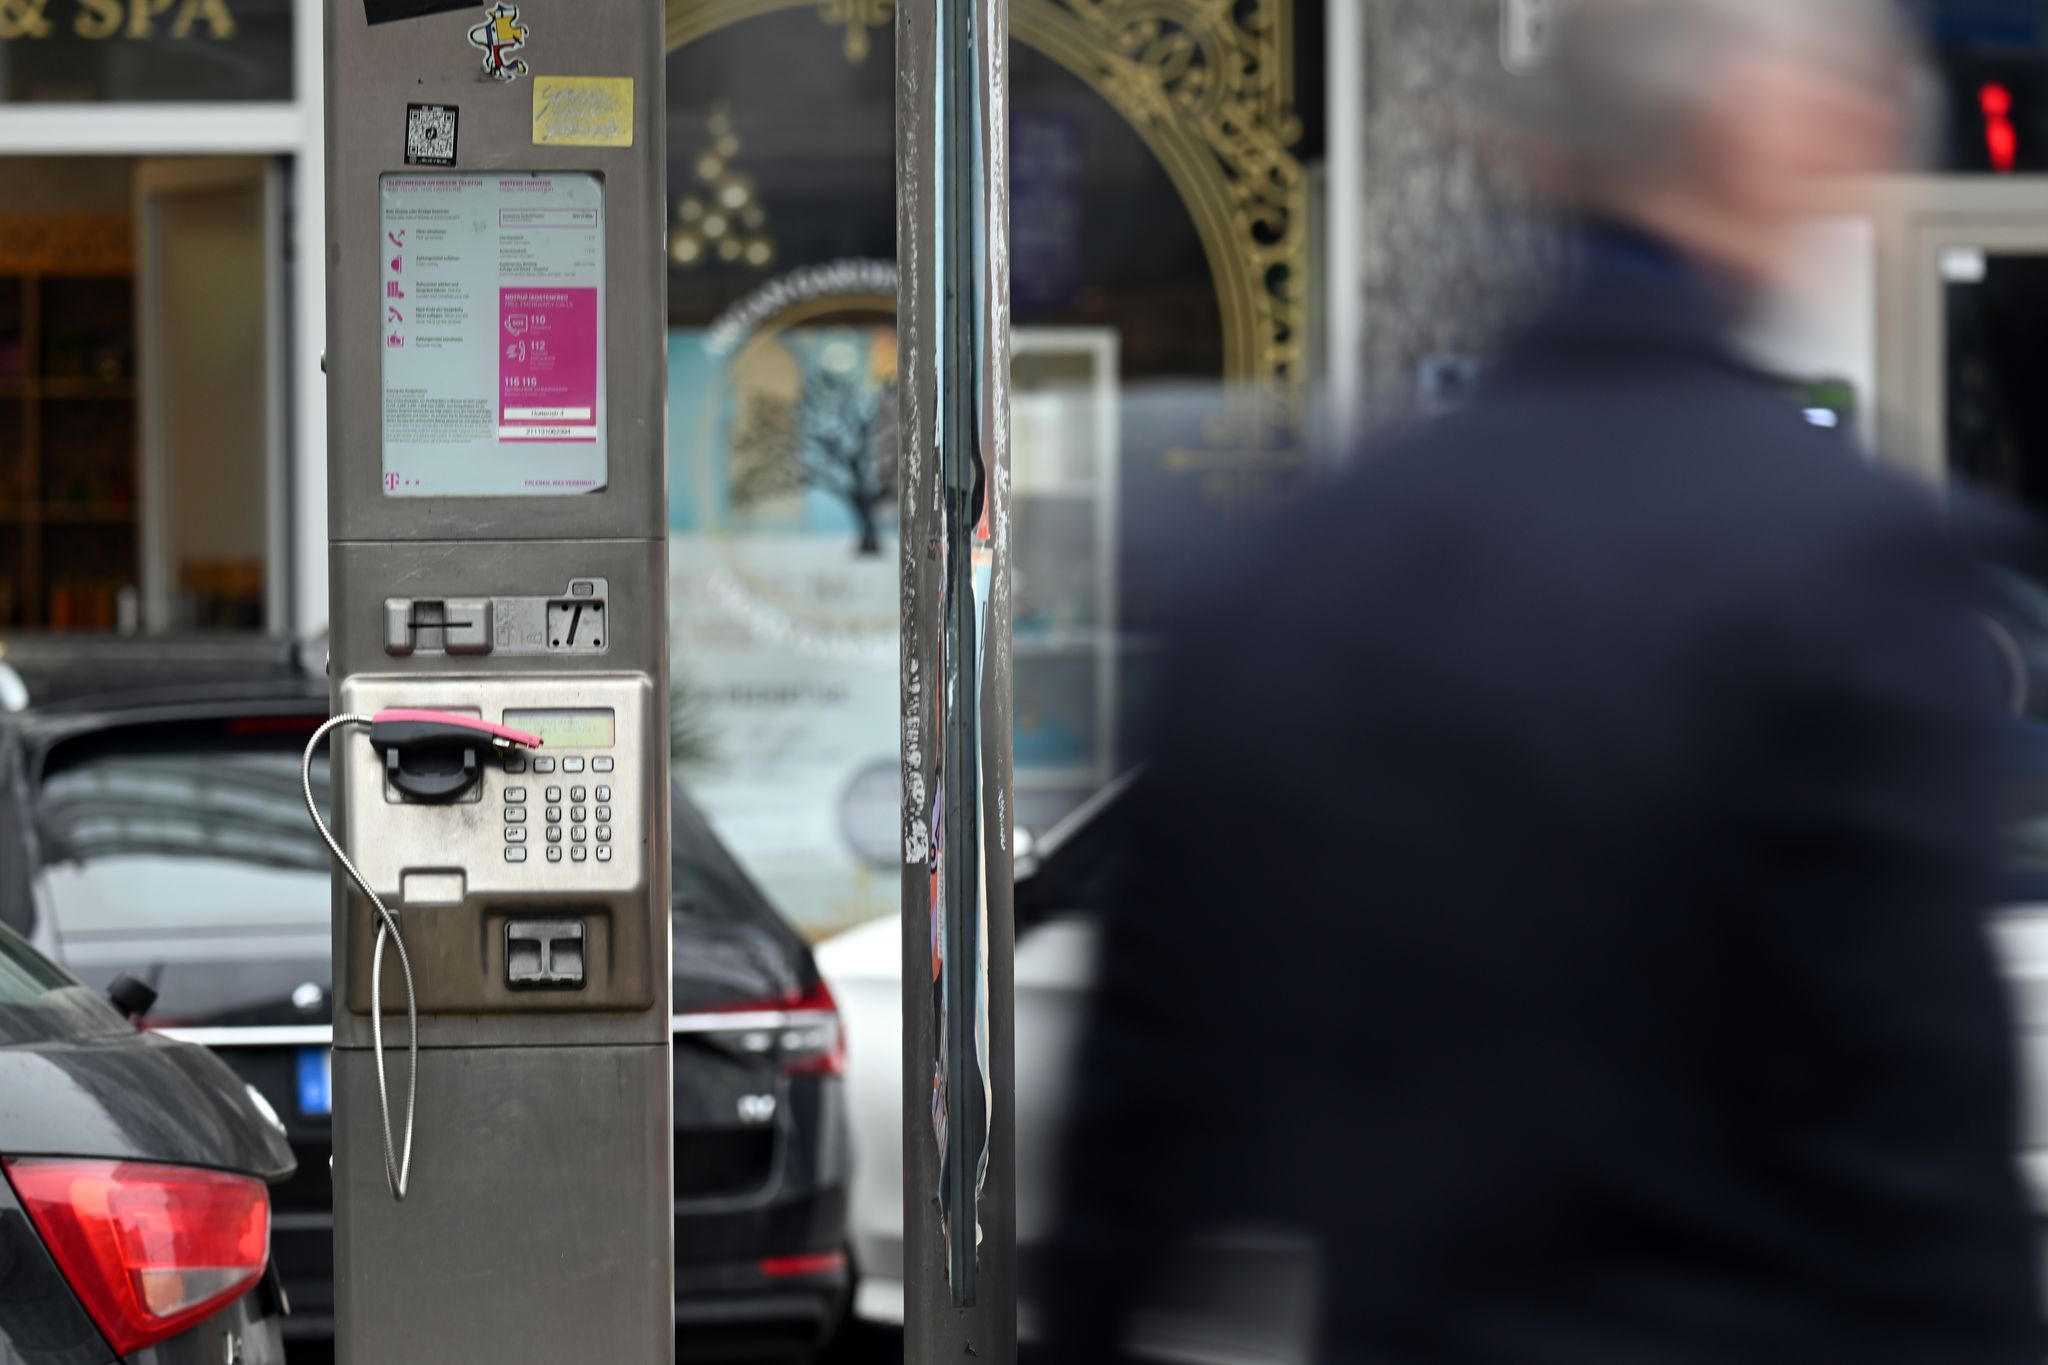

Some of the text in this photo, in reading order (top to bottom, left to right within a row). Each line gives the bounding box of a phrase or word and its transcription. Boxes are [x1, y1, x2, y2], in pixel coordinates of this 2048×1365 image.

[74, 0, 237, 40] SPA
[531, 314, 545, 324] 110
[531, 340, 546, 351] 112
[505, 376, 537, 387] 116 116
